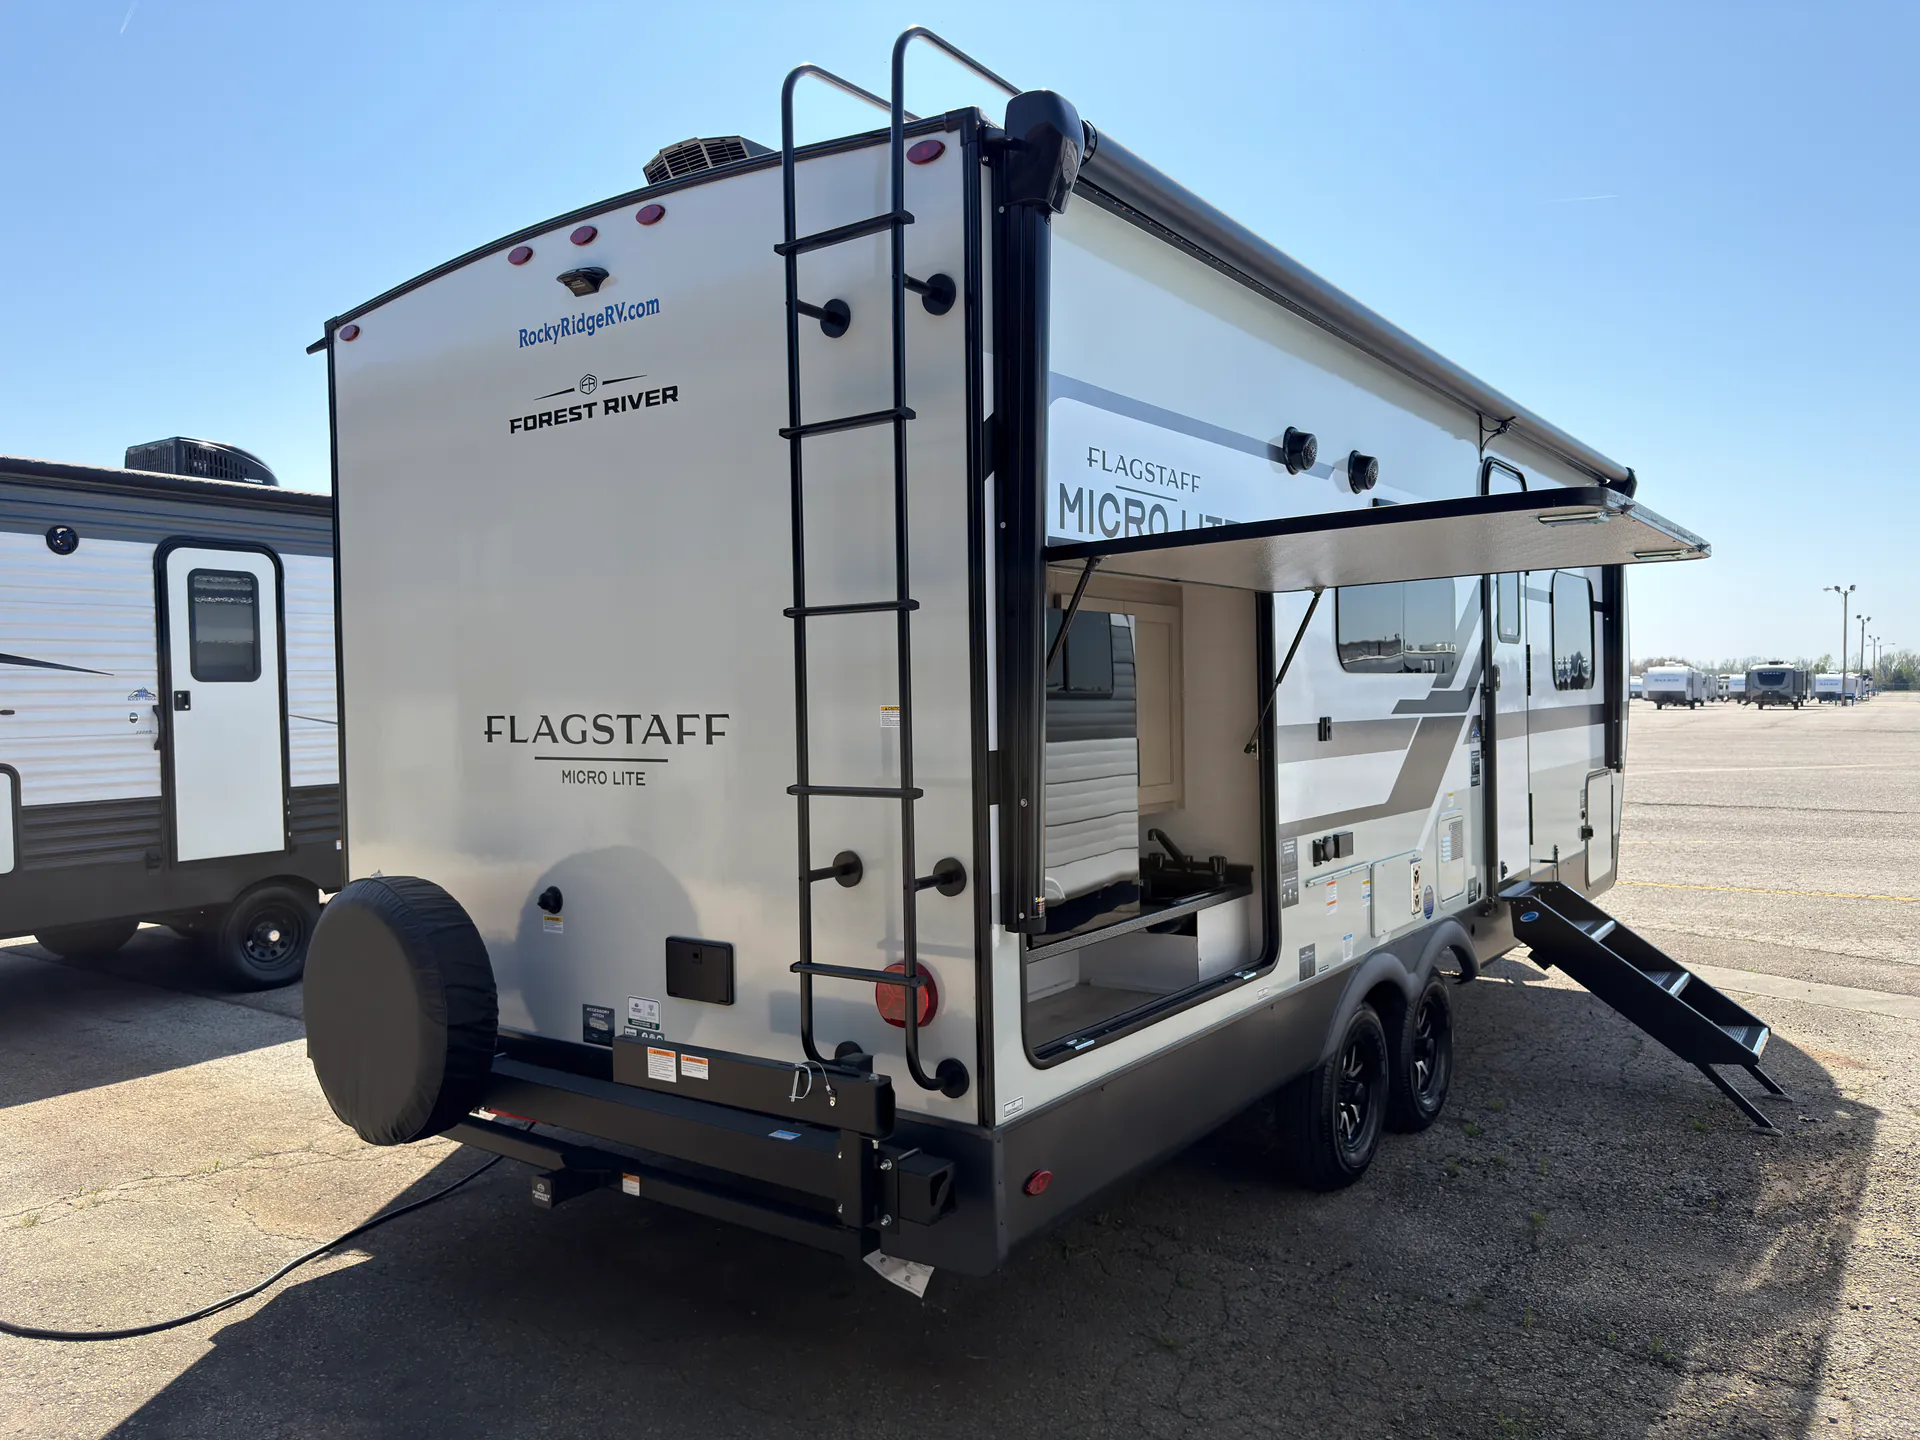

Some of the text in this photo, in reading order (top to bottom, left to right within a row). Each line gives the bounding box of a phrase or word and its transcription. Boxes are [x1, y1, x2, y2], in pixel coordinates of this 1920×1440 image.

[518, 298, 661, 348] RockyRidgeRV.com
[509, 385, 679, 434] FOREST RIVER
[1087, 446, 1201, 493] FLAGSTAFF
[1059, 482, 1169, 539] MICRO
[484, 713, 730, 745] FLAGSTAFF
[561, 769, 646, 786] MICRO LITE
